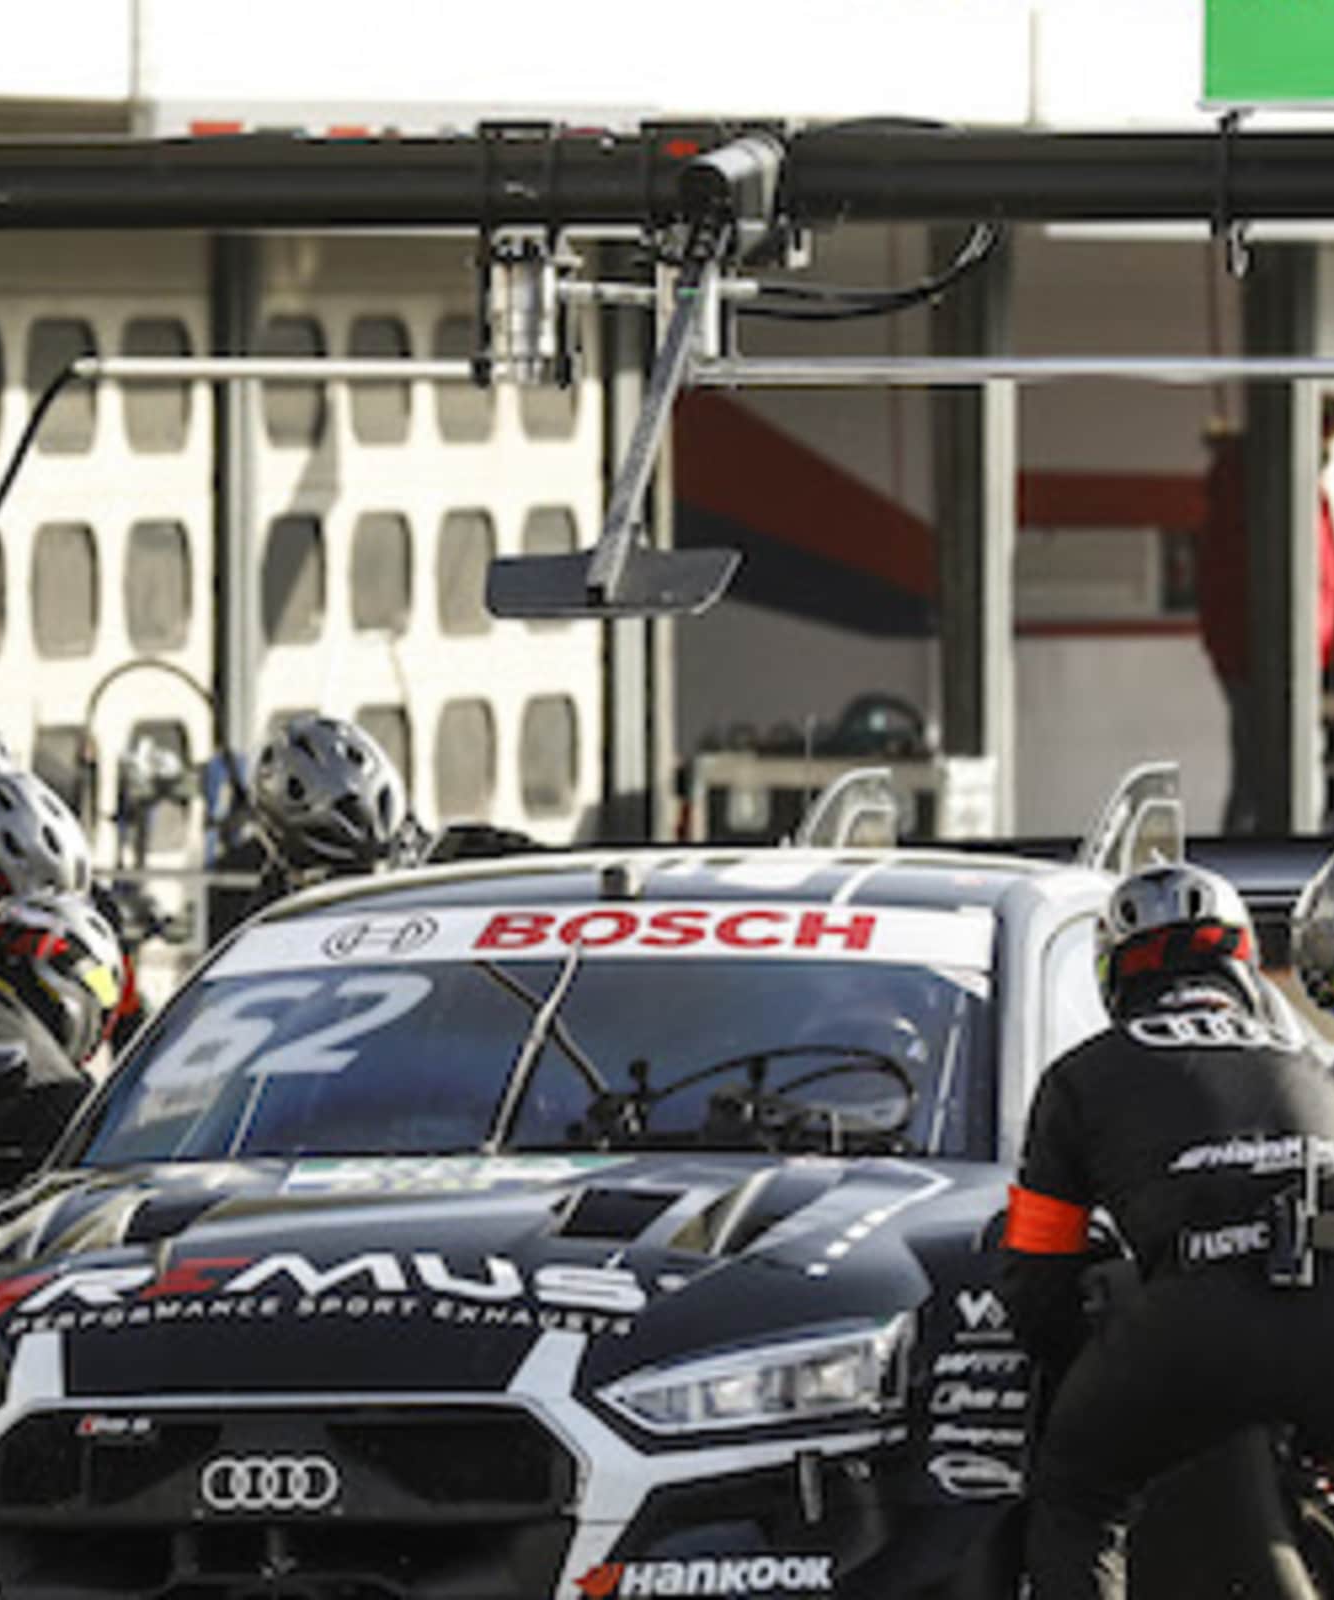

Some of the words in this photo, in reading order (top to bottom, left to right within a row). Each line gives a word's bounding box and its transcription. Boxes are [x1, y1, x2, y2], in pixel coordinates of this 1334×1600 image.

[474, 909, 877, 951] BOSCH
[145, 974, 433, 1085] 62
[18, 1253, 647, 1312] REMUS
[8, 1299, 278, 1334] PERFORMANCE
[297, 1298, 416, 1317] SPORT
[432, 1301, 633, 1335] EXHAUSTS
